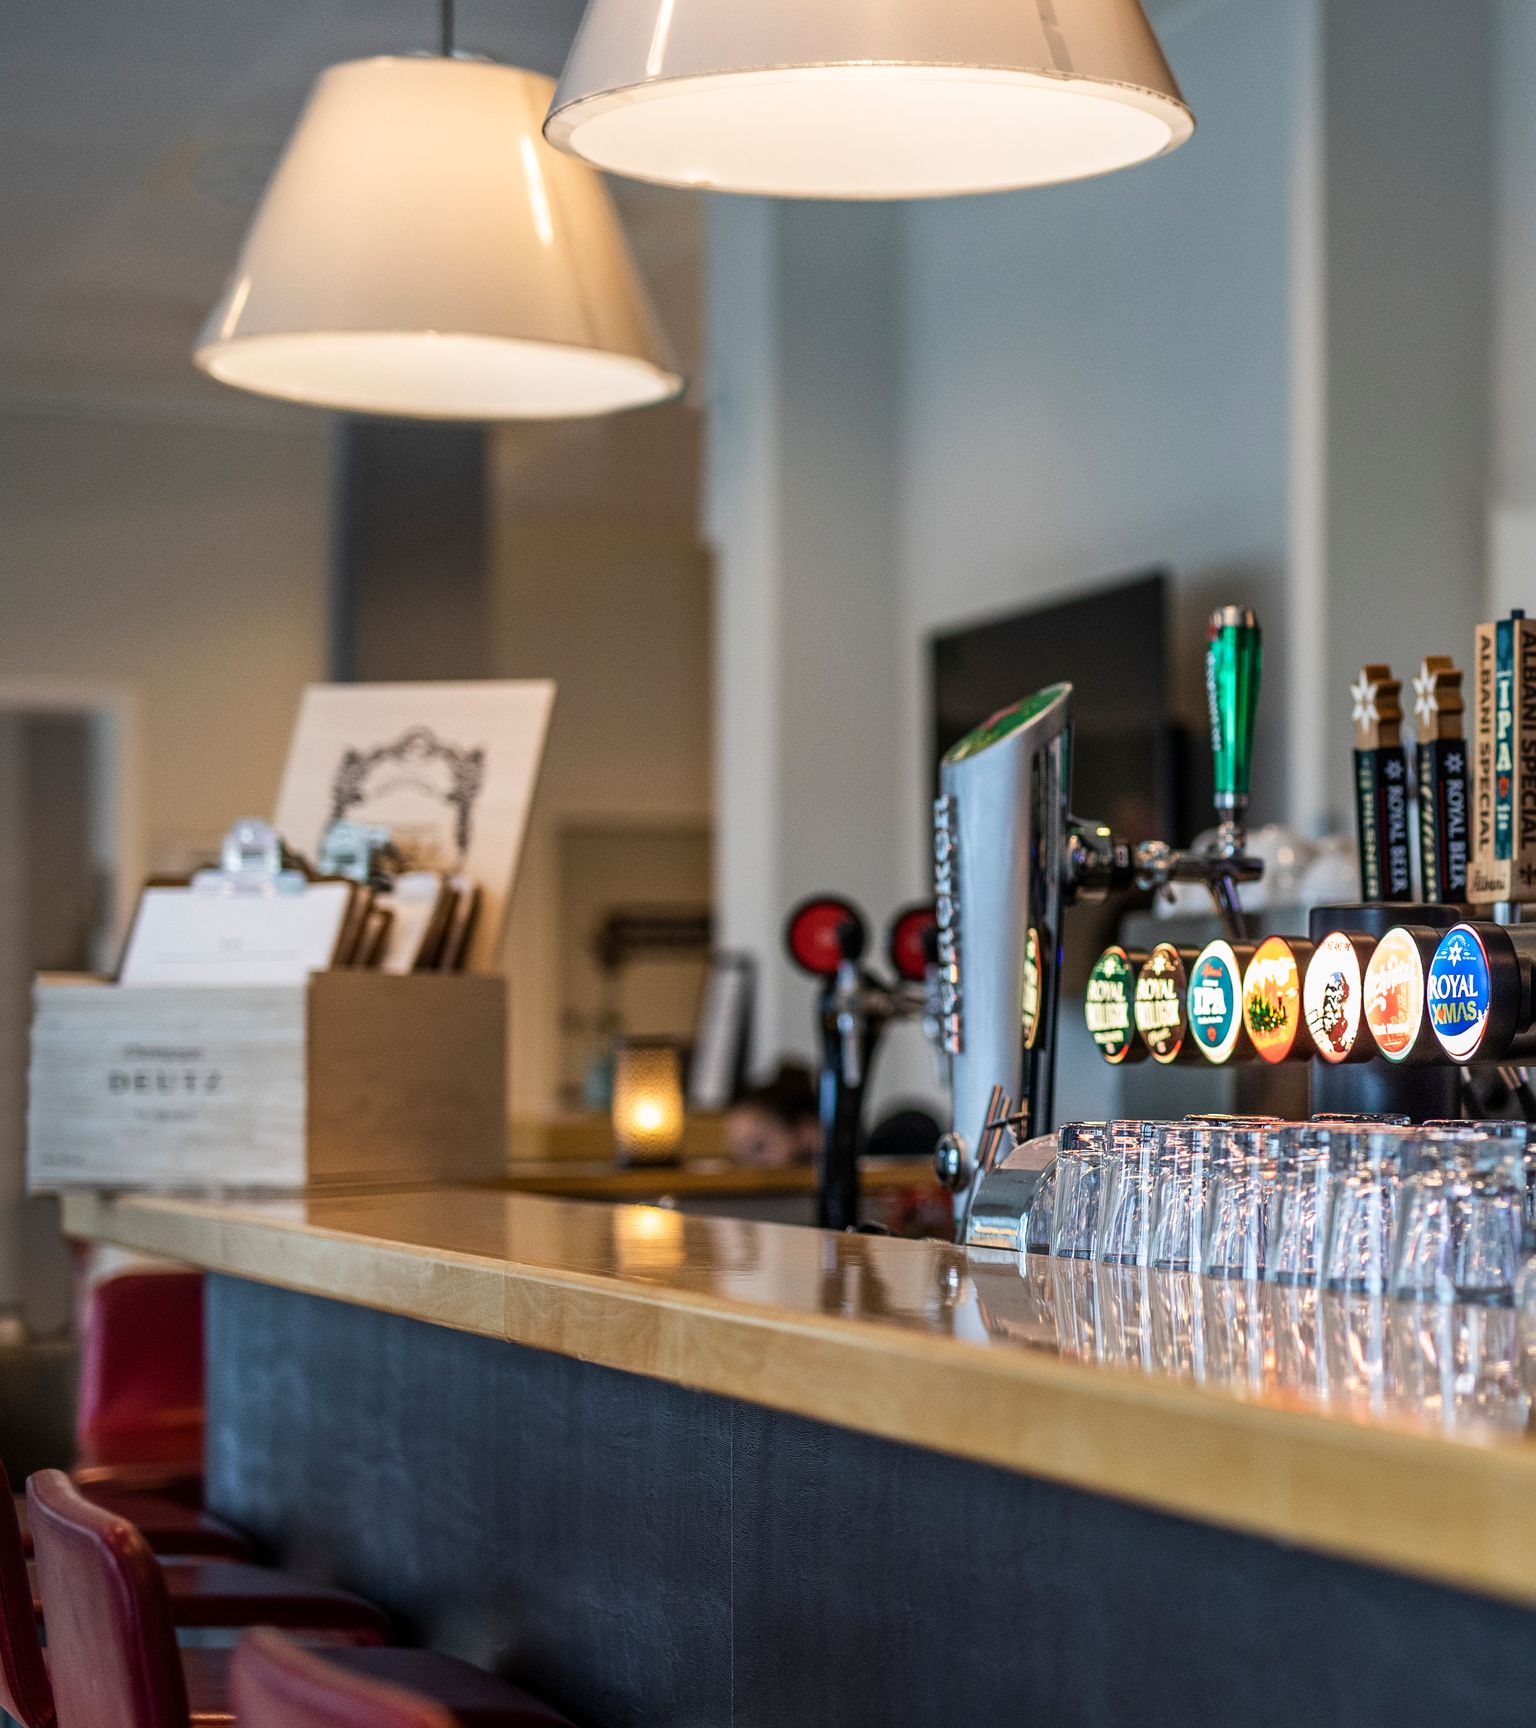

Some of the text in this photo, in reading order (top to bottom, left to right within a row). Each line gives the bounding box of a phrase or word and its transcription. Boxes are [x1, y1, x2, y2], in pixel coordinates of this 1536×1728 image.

[1479, 634, 1492, 846] ALBANI SPECIAL
[1497, 679, 1513, 773] IPA
[1387, 785, 1408, 896] ROYAL BEER
[1446, 778, 1466, 890] ROYAL BEER
[1136, 977, 1177, 1001] ROYAL
[1193, 986, 1227, 1016] IPA
[1429, 974, 1479, 1000] ROYAL
[1430, 1000, 1478, 1025] XMAS
